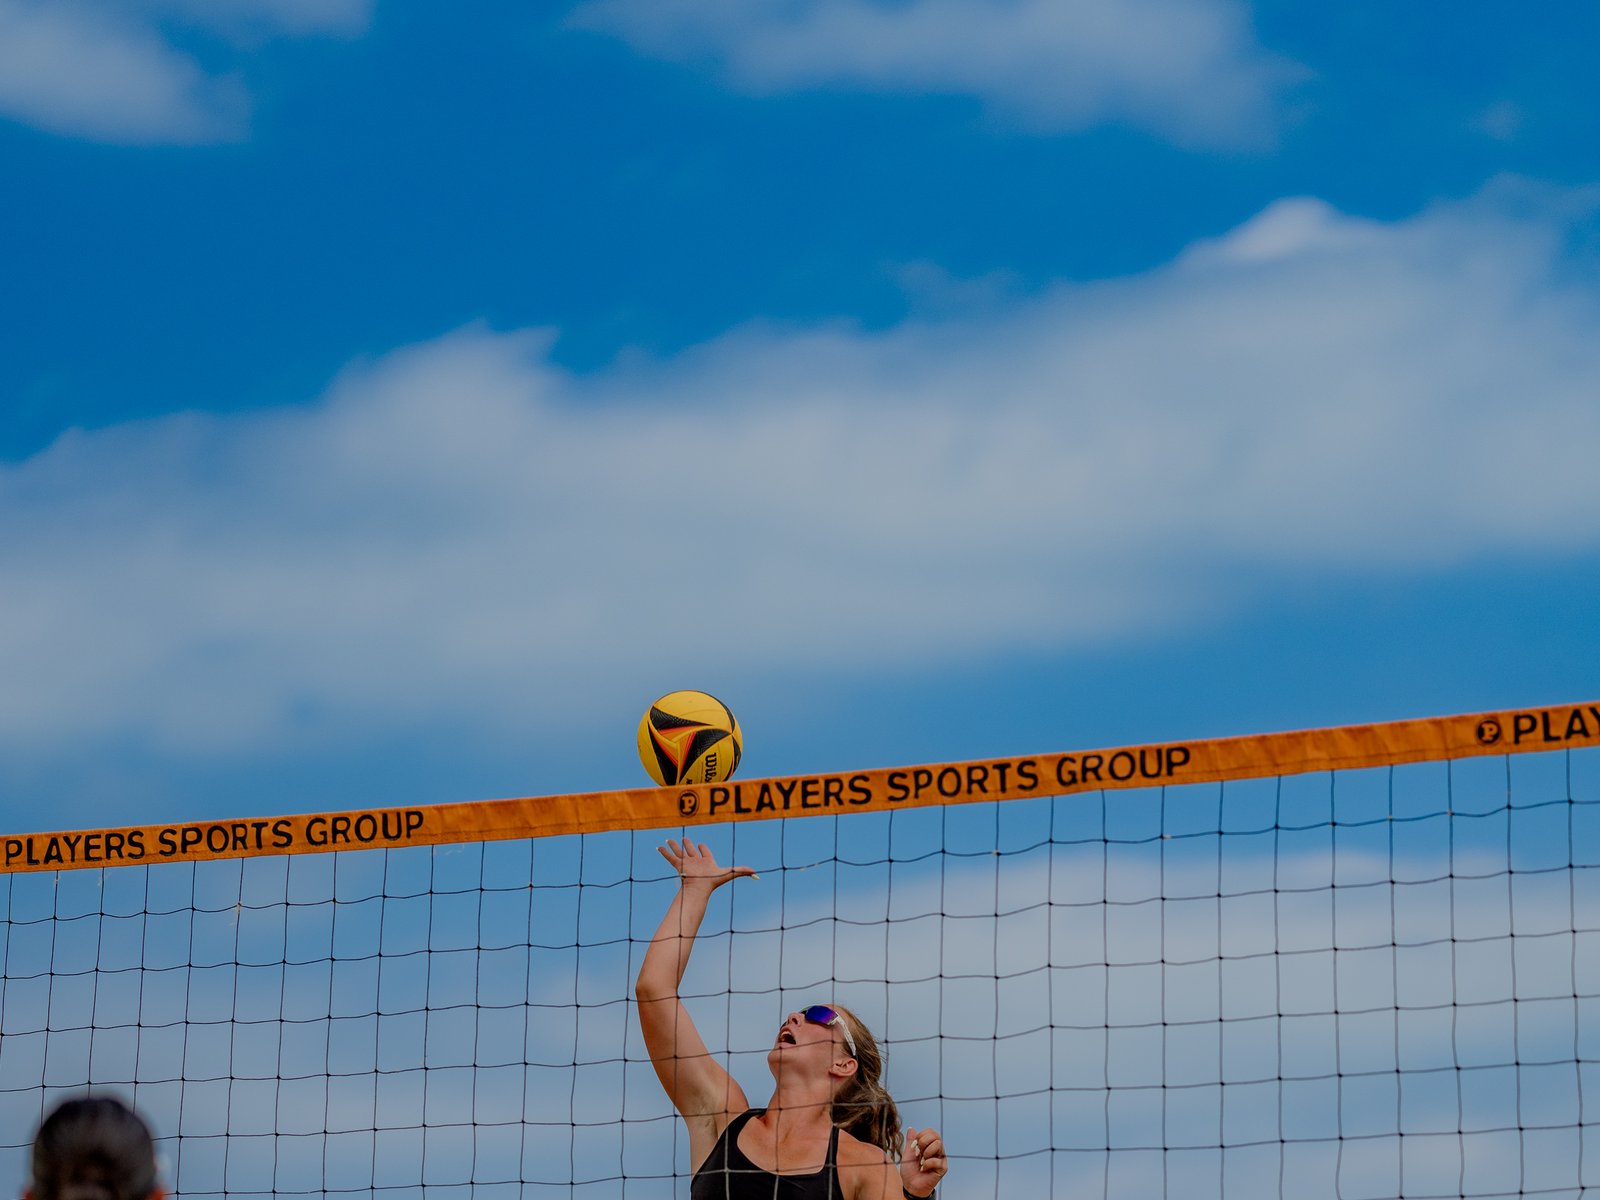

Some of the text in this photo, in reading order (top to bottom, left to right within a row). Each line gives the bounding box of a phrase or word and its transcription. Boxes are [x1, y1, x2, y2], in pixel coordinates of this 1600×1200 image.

[709, 775, 873, 816] PLAYERS
[887, 760, 1038, 802] SPORTS
[1057, 746, 1191, 786] GROUP
[5, 810, 424, 867] PLAYERS SPORTS GROUP
